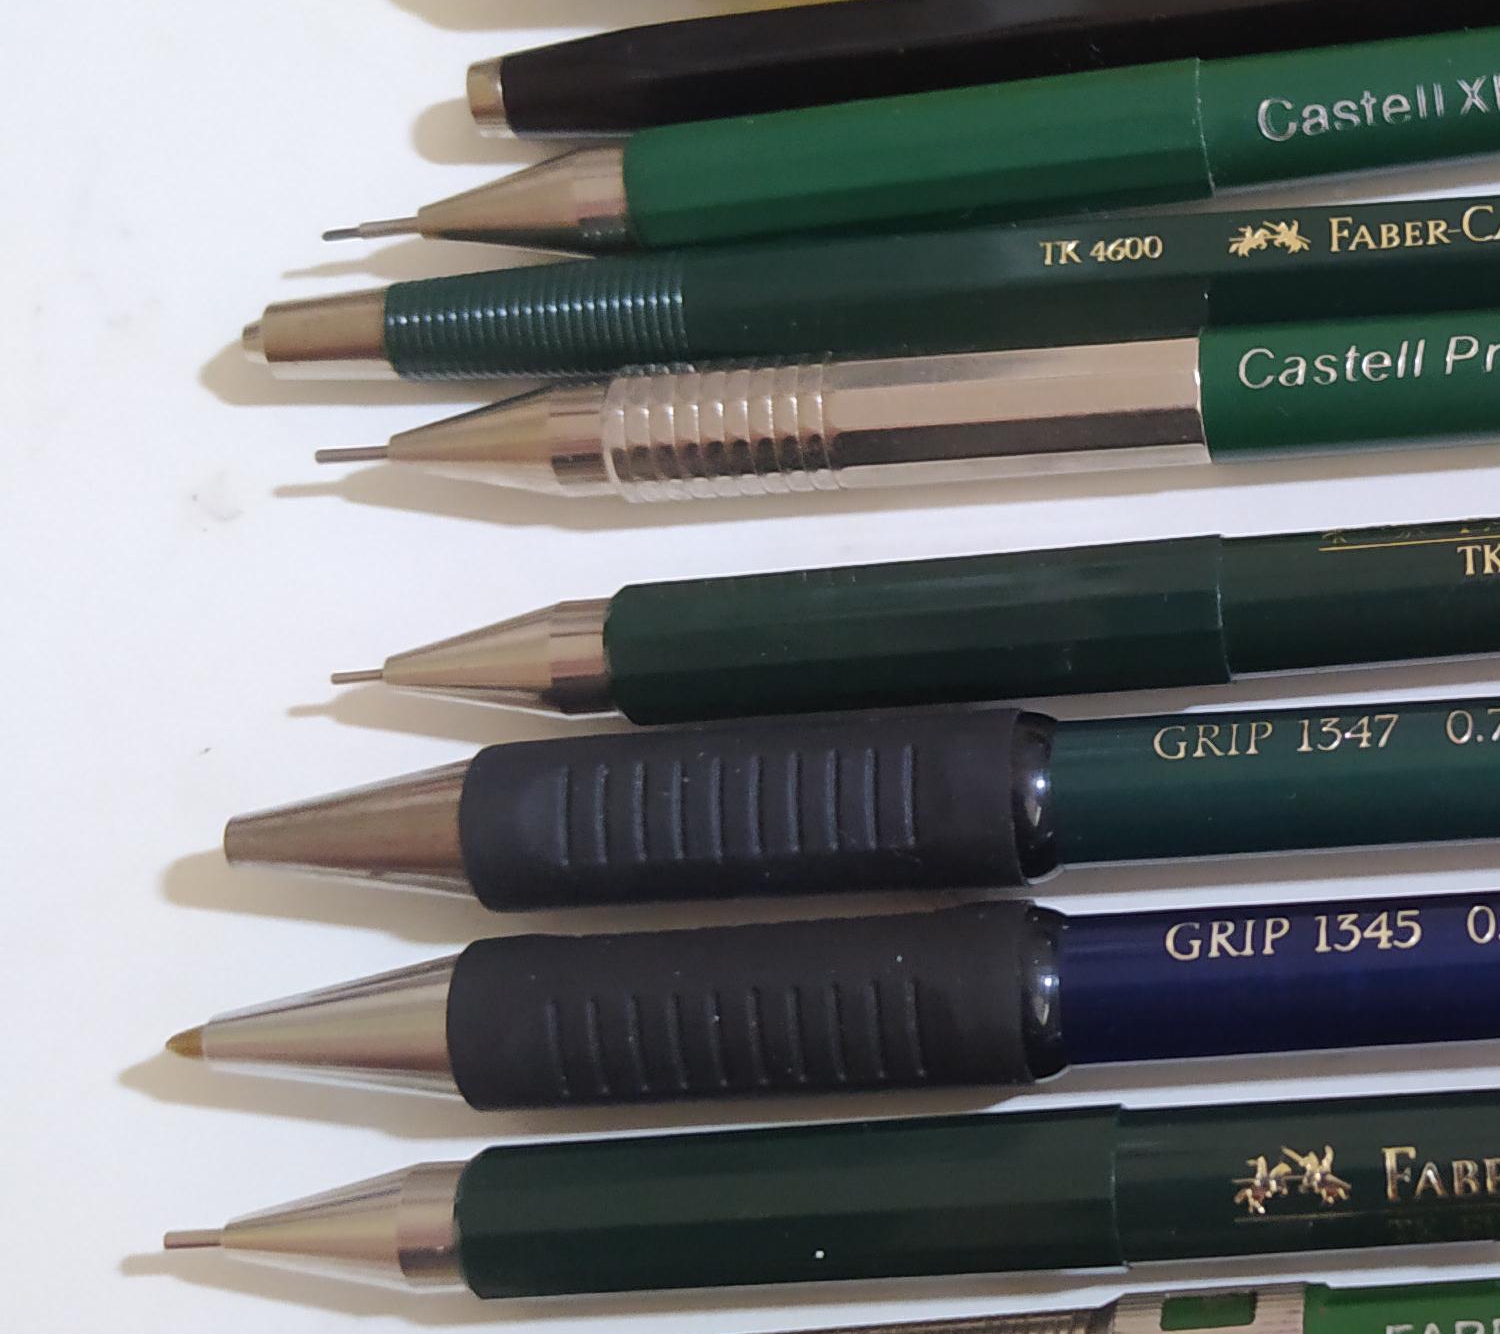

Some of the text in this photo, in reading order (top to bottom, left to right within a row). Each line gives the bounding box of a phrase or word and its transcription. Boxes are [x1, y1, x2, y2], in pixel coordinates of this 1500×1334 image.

[1257, 80, 1444, 142] Castell
[1039, 240, 1083, 267] TK
[1089, 234, 1164, 264] 4600
[1237, 336, 1426, 391] Castell
[1153, 720, 1274, 760] GRIP
[1296, 713, 1400, 753] 1347
[1164, 916, 1291, 961] GRIP
[1313, 908, 1423, 953] 1345
